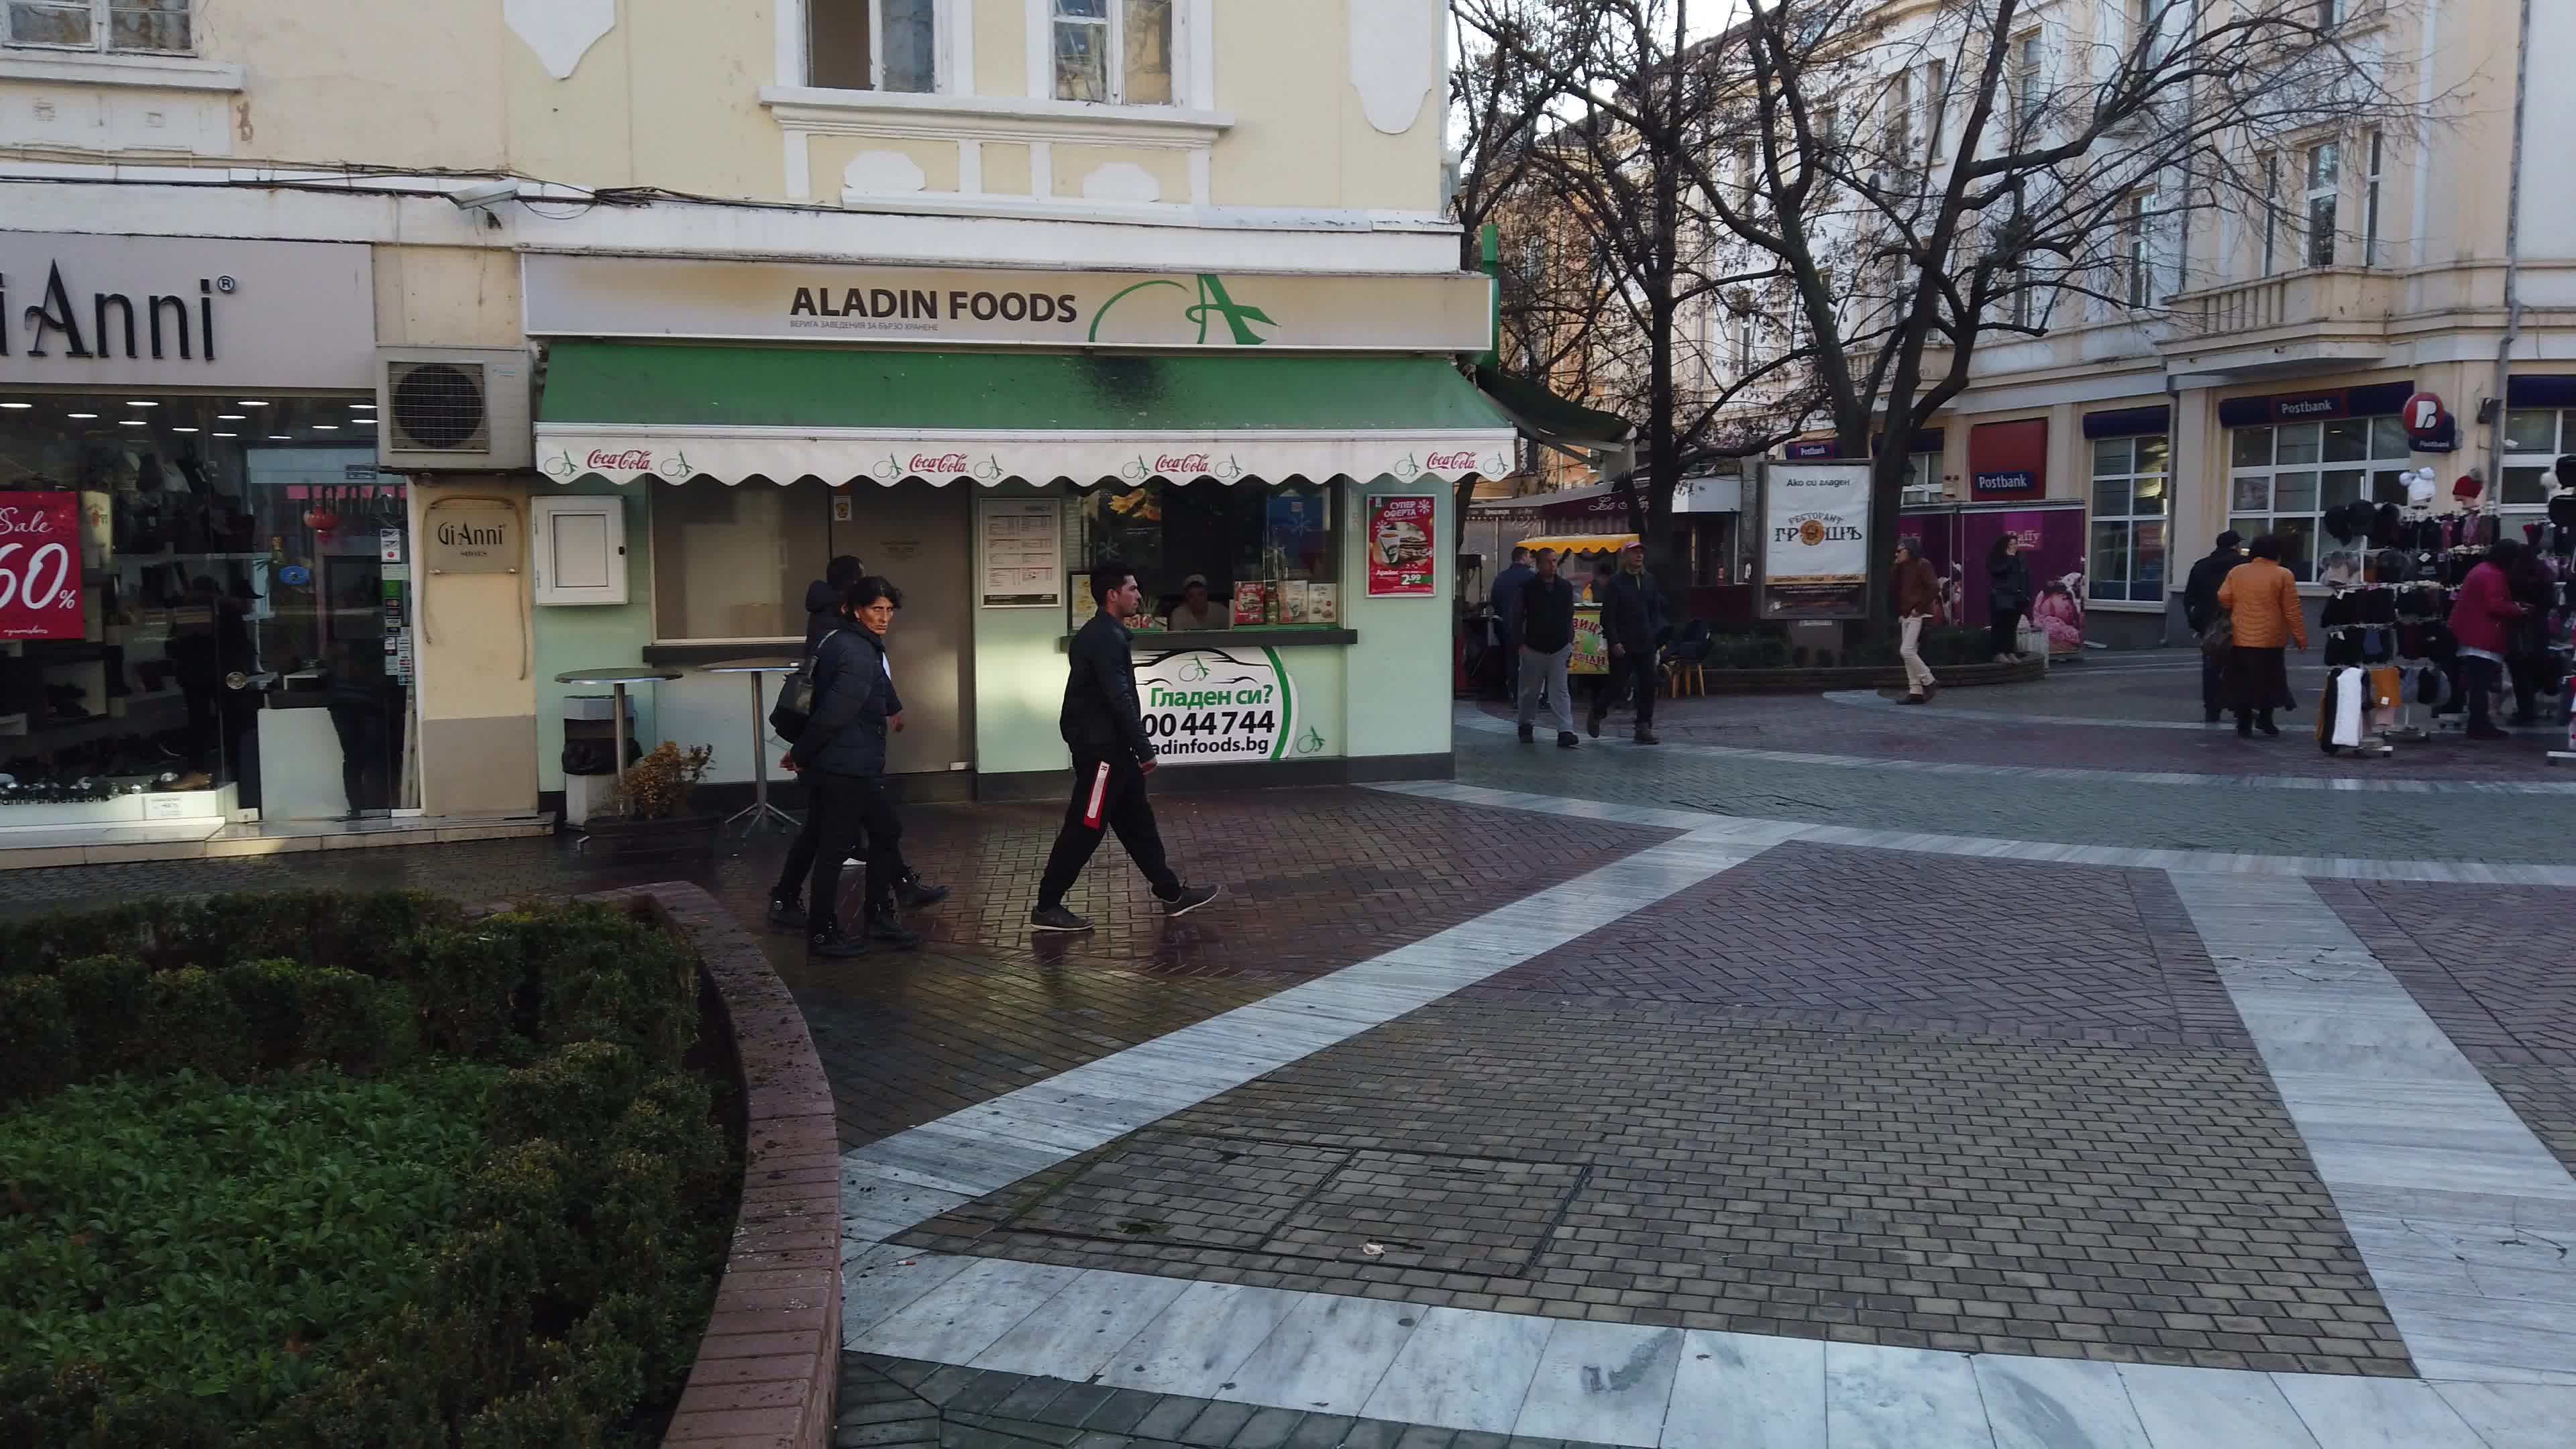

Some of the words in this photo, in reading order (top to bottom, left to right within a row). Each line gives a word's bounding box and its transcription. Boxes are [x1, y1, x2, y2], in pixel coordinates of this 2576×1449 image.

[790, 286, 938, 319] ALADIN
[949, 290, 1077, 323] FOODS
[790, 320, 818, 328] ВЕРИГА
[820, 321, 865, 329] ЗАВЕДЕНИЯ
[878, 322, 903, 331] БЪРЗО
[904, 323, 938, 331] ХРАНЕНЕ
[2281, 400, 2332, 414] Postbank
[2420, 439, 2450, 447] Postbank
[587, 449, 652, 470] Coca-Cola
[910, 453, 968, 472] Coca-Cola
[1155, 453, 1210, 472] Coca-Cola
[1427, 451, 1477, 470] Coca-Cola
[1787, 479, 1804, 487] Ако
[1979, 474, 2028, 489] Postbank
[1389, 500, 1416, 510] СУПЕР
[0, 506, 54, 535] Sale
[1383, 508, 1417, 518] ОФЕРТА
[1788, 512, 1845, 525] РЕСТОРАНТ
[1150, 687, 1231, 710] Гладен
[1236, 684, 1273, 704] си?
